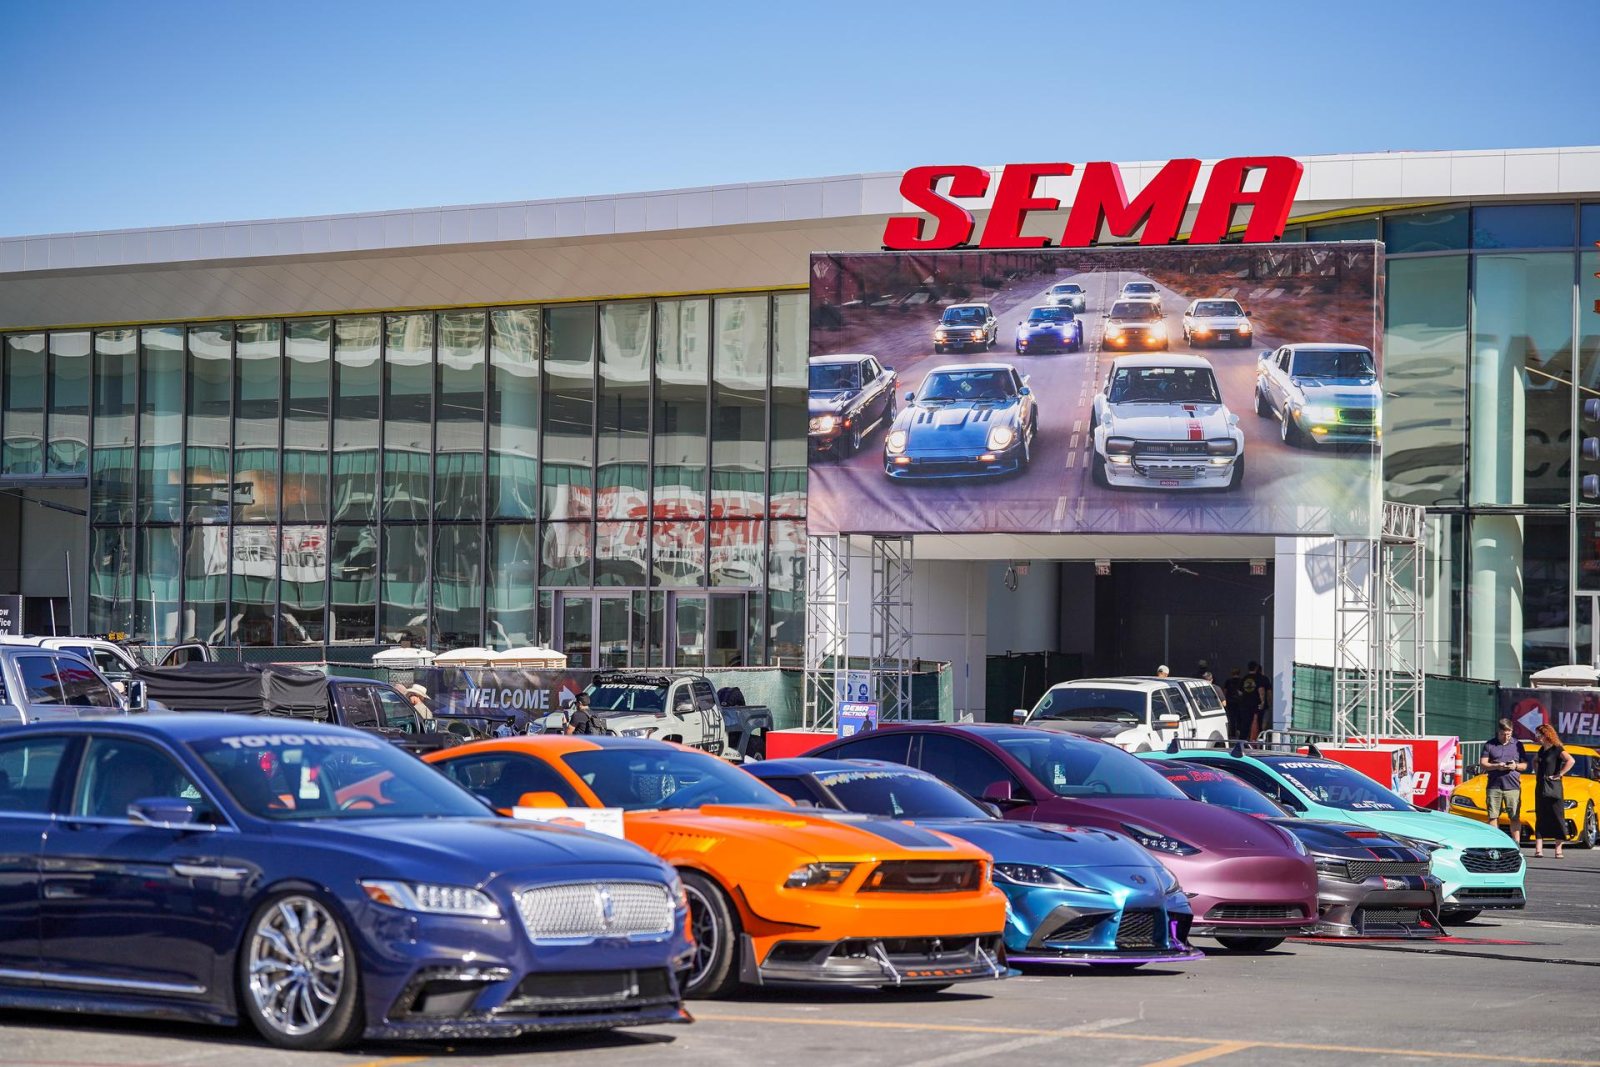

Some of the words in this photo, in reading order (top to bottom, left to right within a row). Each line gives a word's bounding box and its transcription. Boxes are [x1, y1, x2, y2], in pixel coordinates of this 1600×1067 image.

[883, 155, 1304, 250] SEMA
[465, 687, 550, 710] WELCOME
[221, 734, 304, 749] TOYO
